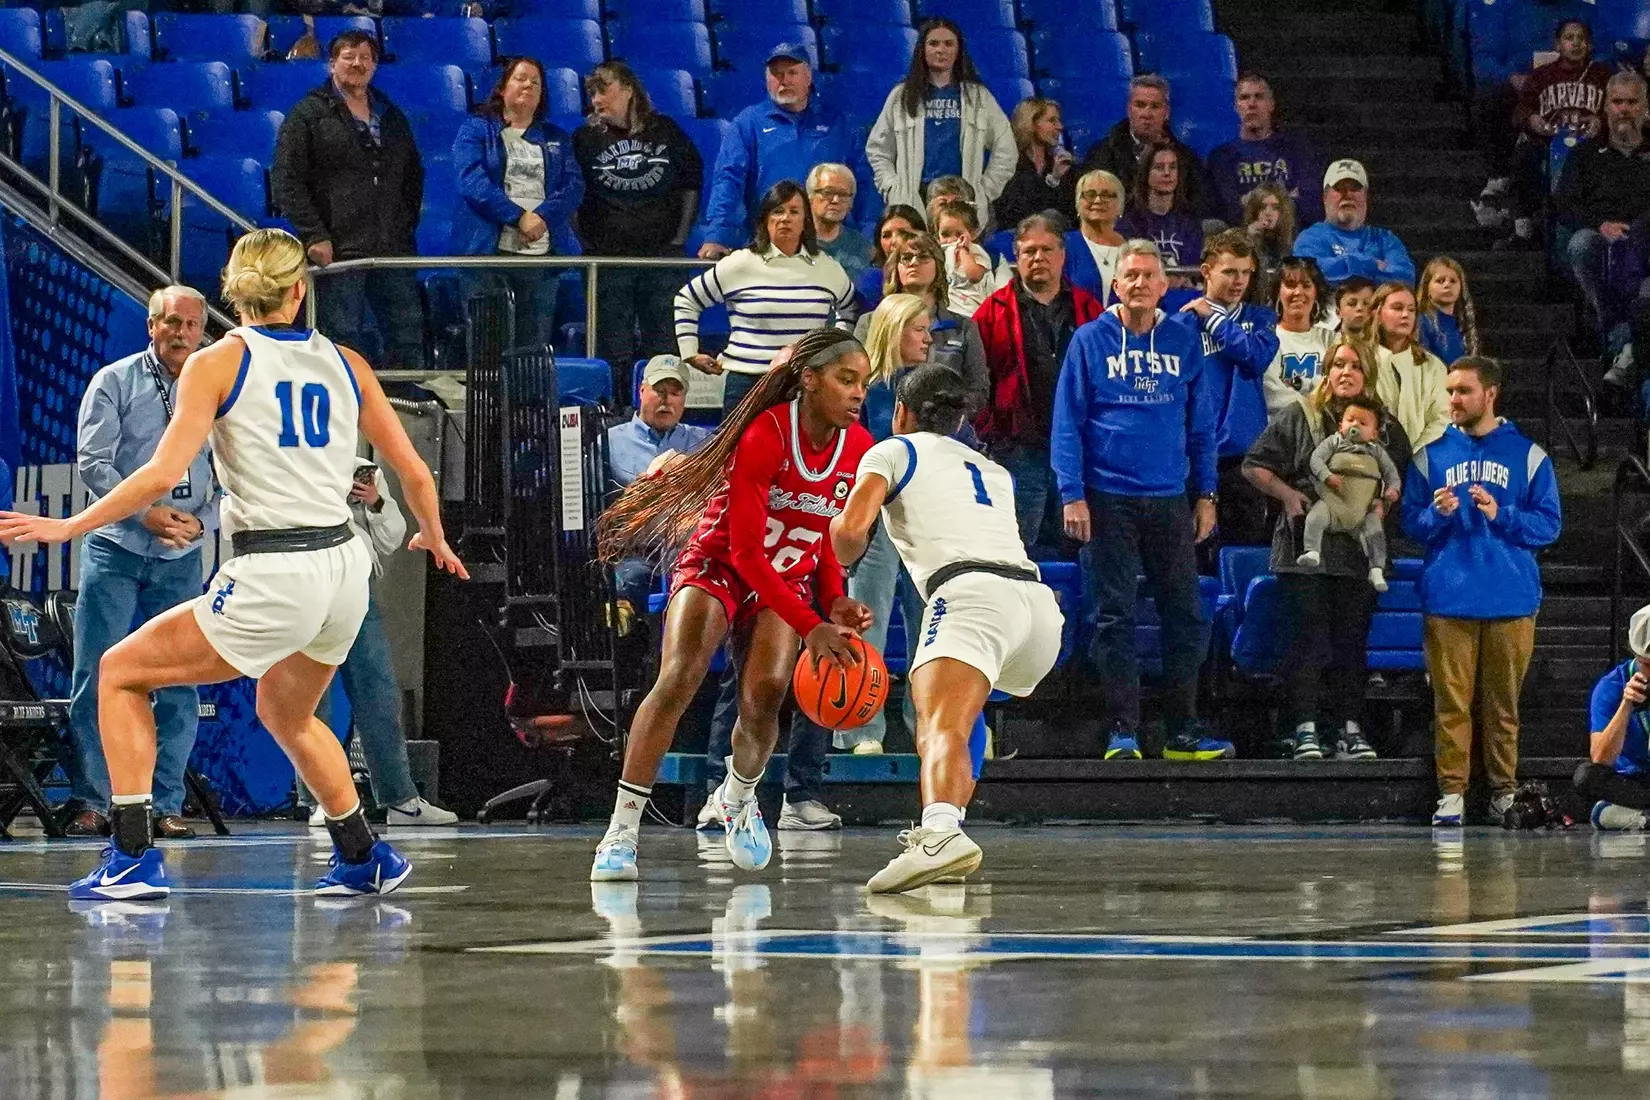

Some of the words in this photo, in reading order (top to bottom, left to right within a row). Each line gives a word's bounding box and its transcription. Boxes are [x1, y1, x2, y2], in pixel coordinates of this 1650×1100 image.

[1106, 350, 1181, 379] MTSU
[1134, 376, 1159, 393] MT
[275, 381, 331, 448] 10
[964, 460, 993, 508] 1
[1445, 461, 1469, 488] BLUE
[857, 667, 882, 719] ELITE
